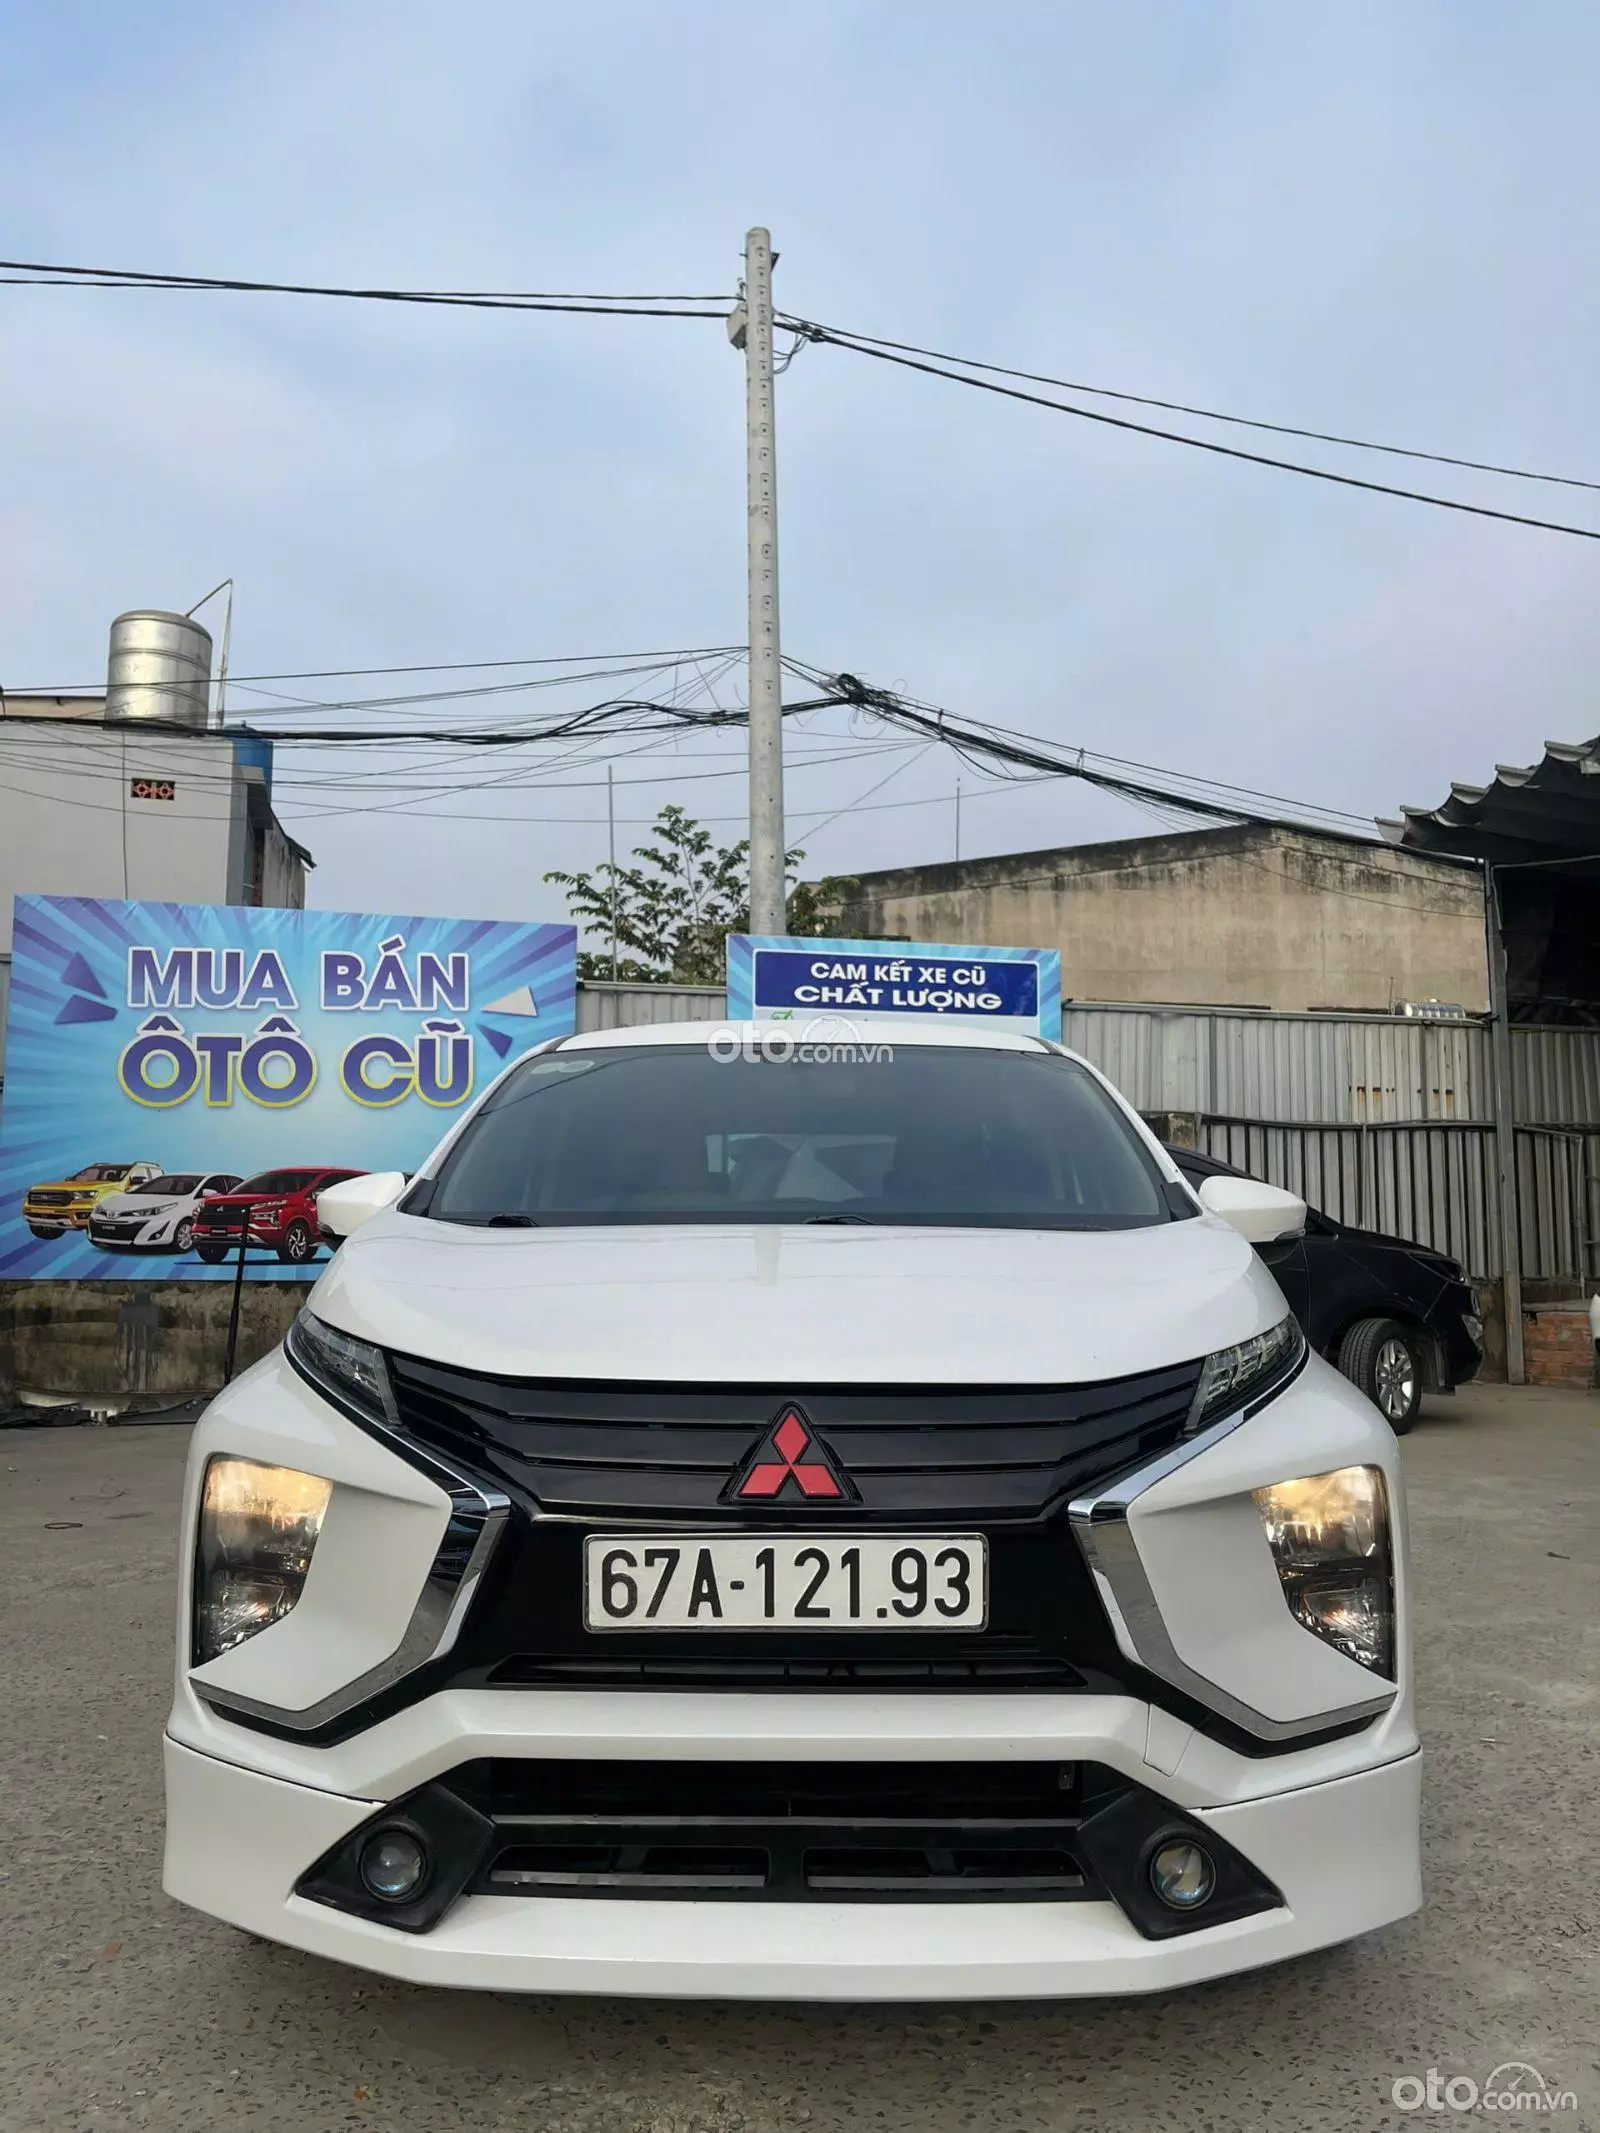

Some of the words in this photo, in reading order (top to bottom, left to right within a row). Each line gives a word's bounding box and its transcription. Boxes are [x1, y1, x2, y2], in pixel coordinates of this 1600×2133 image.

[128, 945, 299, 1009] MUA
[320, 934, 470, 1011] BÁN
[793, 981, 884, 1006] CHẤT
[892, 987, 1002, 1013] LƯỢNG
[809, 961, 867, 982] CAM
[874, 960, 913, 983] KẾT
[918, 966, 947, 985] XE
[952, 965, 986, 986] CŨ
[117, 1013, 318, 1108] ÔTÔ
[339, 1019, 474, 1108] CŨ
[600, 1546, 972, 1619] 67A-121.93
